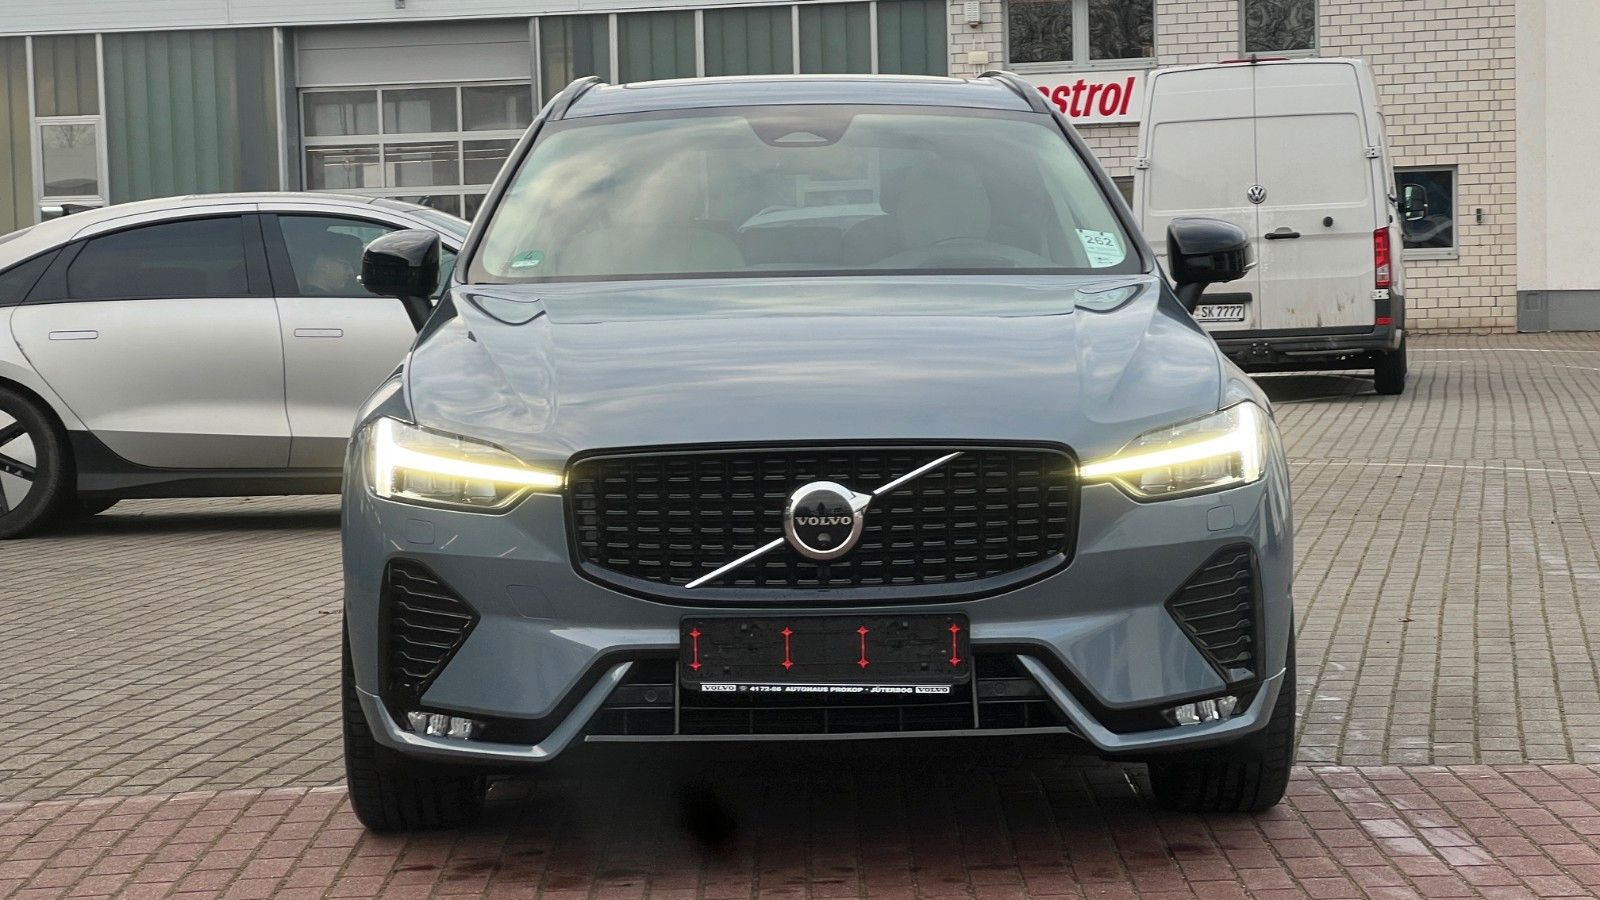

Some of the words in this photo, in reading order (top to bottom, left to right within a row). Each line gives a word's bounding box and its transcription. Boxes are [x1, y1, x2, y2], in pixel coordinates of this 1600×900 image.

[1085, 235, 1114, 247] 262
[1201, 306, 1214, 318] SK
[1217, 305, 1243, 317] 7777
[795, 516, 852, 526] VOLVO
